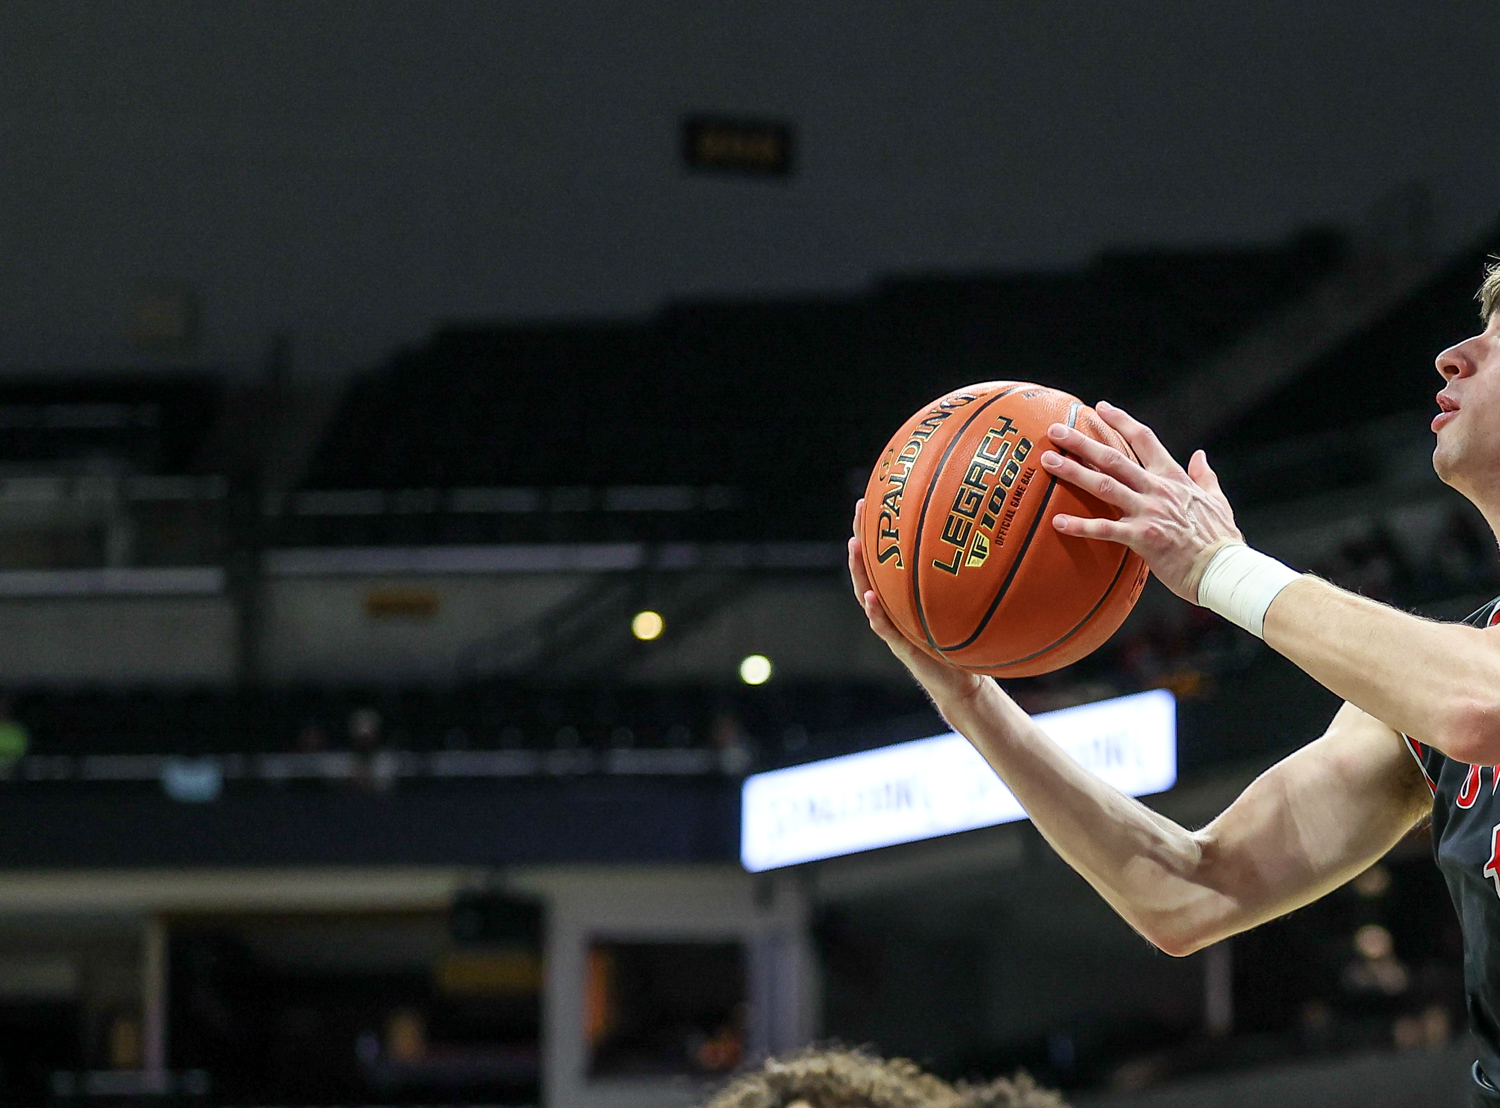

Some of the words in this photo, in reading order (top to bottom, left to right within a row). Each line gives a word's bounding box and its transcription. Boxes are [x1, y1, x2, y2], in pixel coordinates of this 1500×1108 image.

[877, 393, 978, 569] SPALDING
[932, 415, 1019, 576] LEGACY
[980, 437, 1034, 531] 1000
[995, 509, 1017, 547] OFFICIAL
[1010, 484, 1027, 509] GAME
[1020, 466, 1037, 487] BALL
